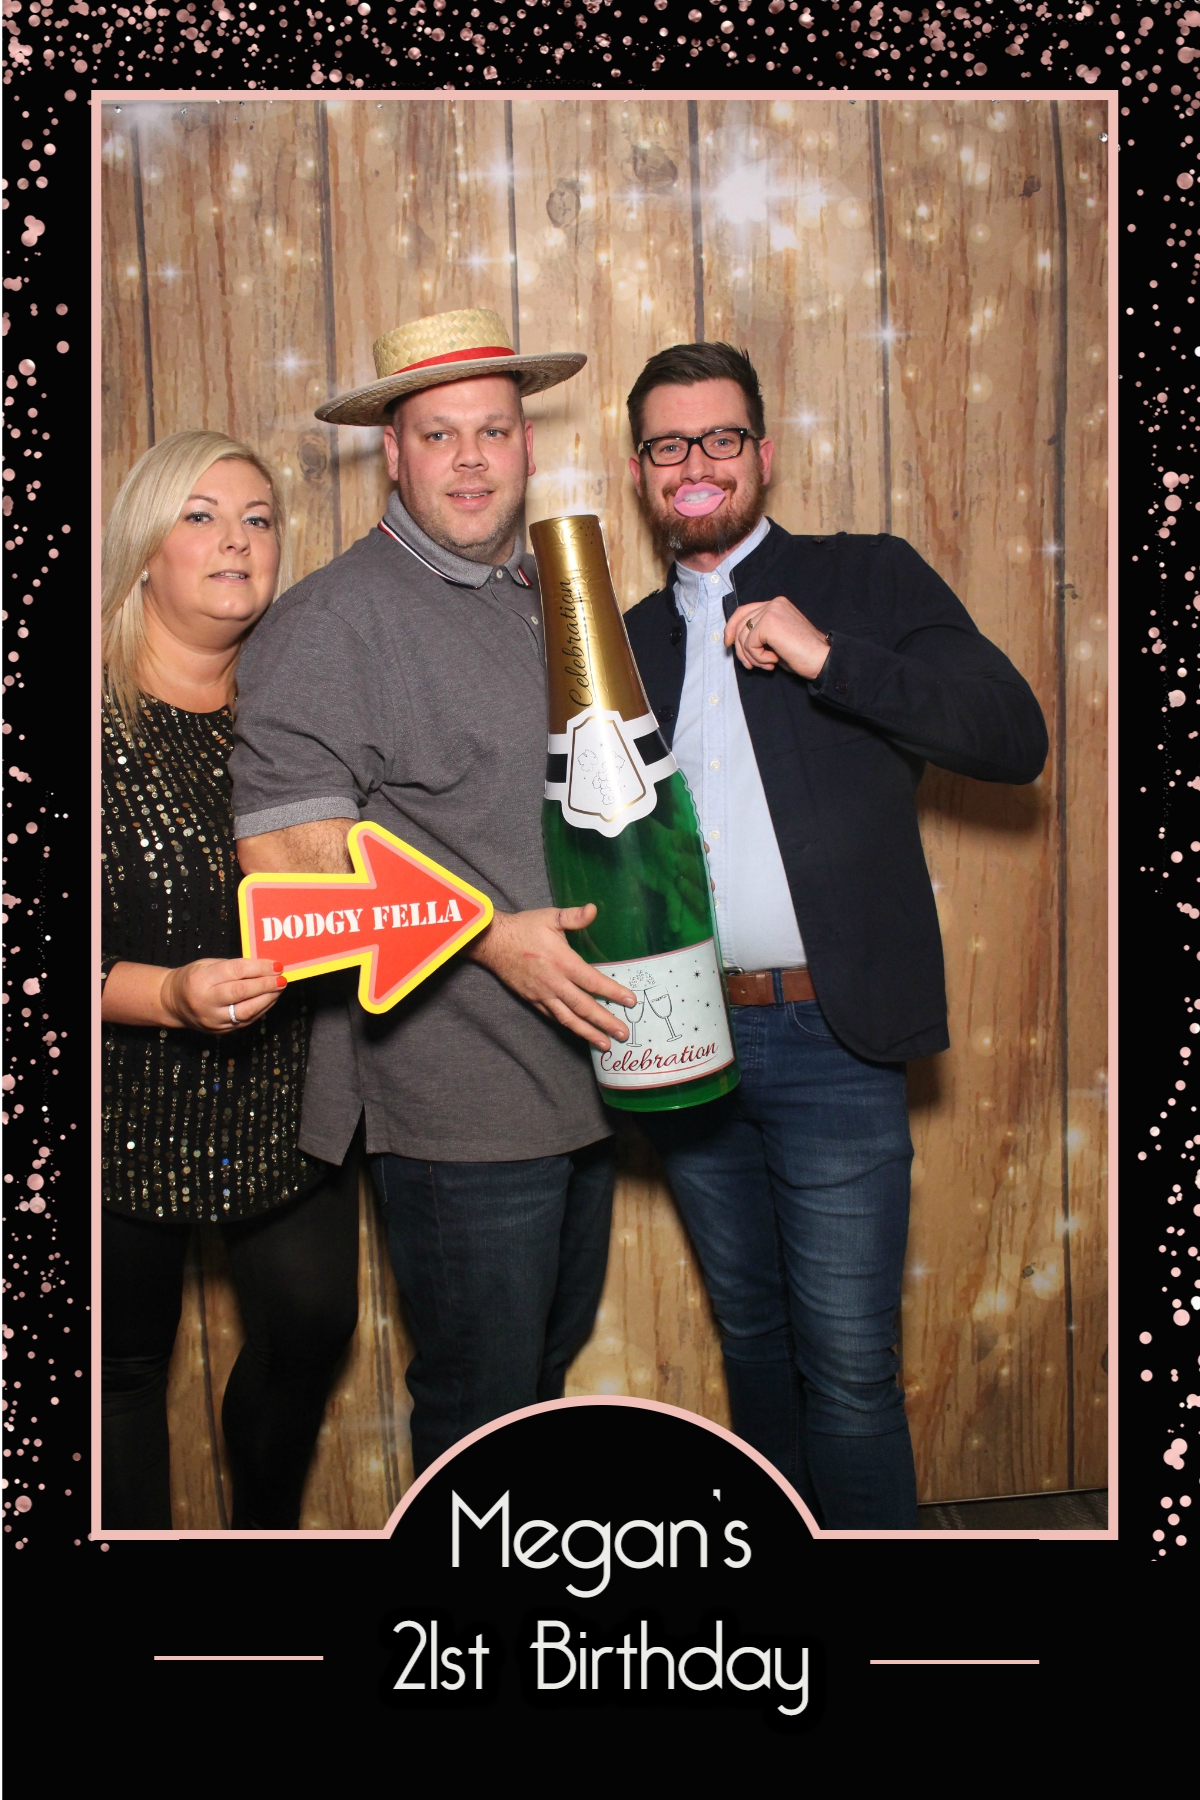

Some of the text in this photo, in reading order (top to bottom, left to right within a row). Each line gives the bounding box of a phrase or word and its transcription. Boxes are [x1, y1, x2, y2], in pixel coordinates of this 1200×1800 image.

[559, 576, 593, 708] Celebration
[261, 899, 463, 942] DODGY FELLA
[600, 1042, 718, 1072] Celebration
